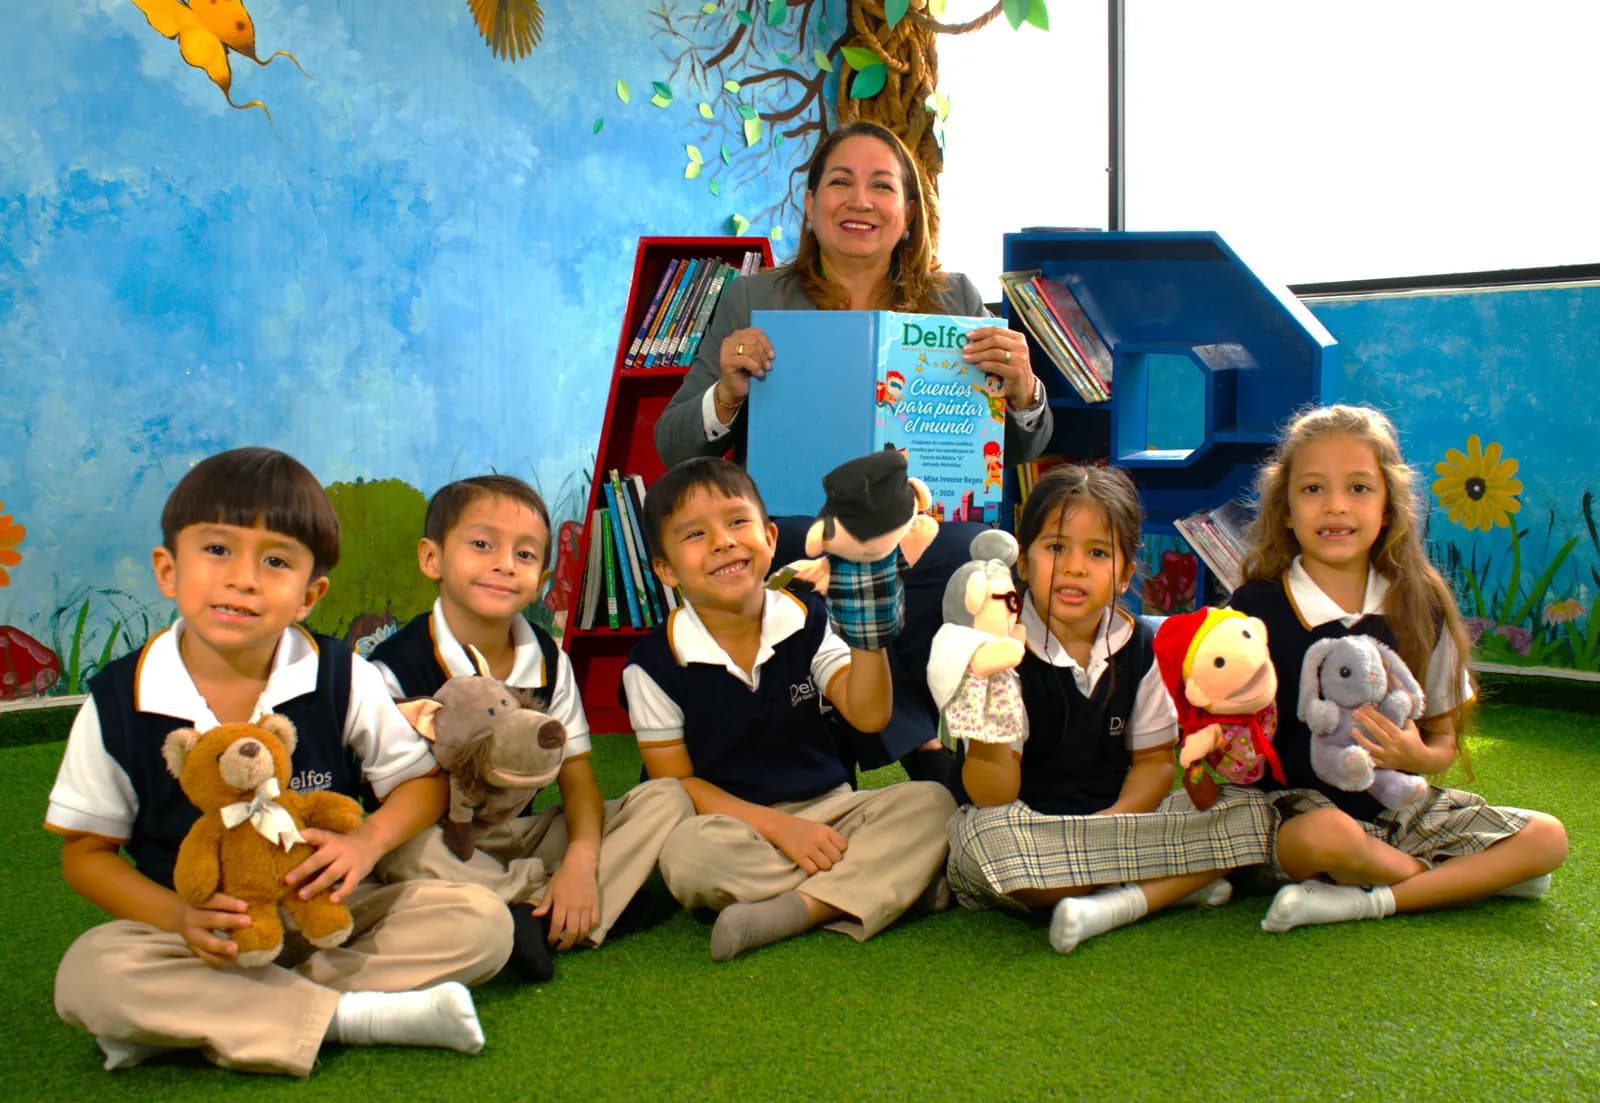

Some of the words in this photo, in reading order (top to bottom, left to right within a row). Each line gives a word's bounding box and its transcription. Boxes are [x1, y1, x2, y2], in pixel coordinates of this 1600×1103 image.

[902, 323, 969, 349] Delfo
[910, 378, 972, 397] Cuentos
[894, 400, 933, 416] para
[933, 399, 983, 418] pintar
[904, 416, 921, 432] el
[920, 418, 974, 435] mundo
[963, 476, 983, 485] Reyes
[290, 769, 332, 789] elfos
